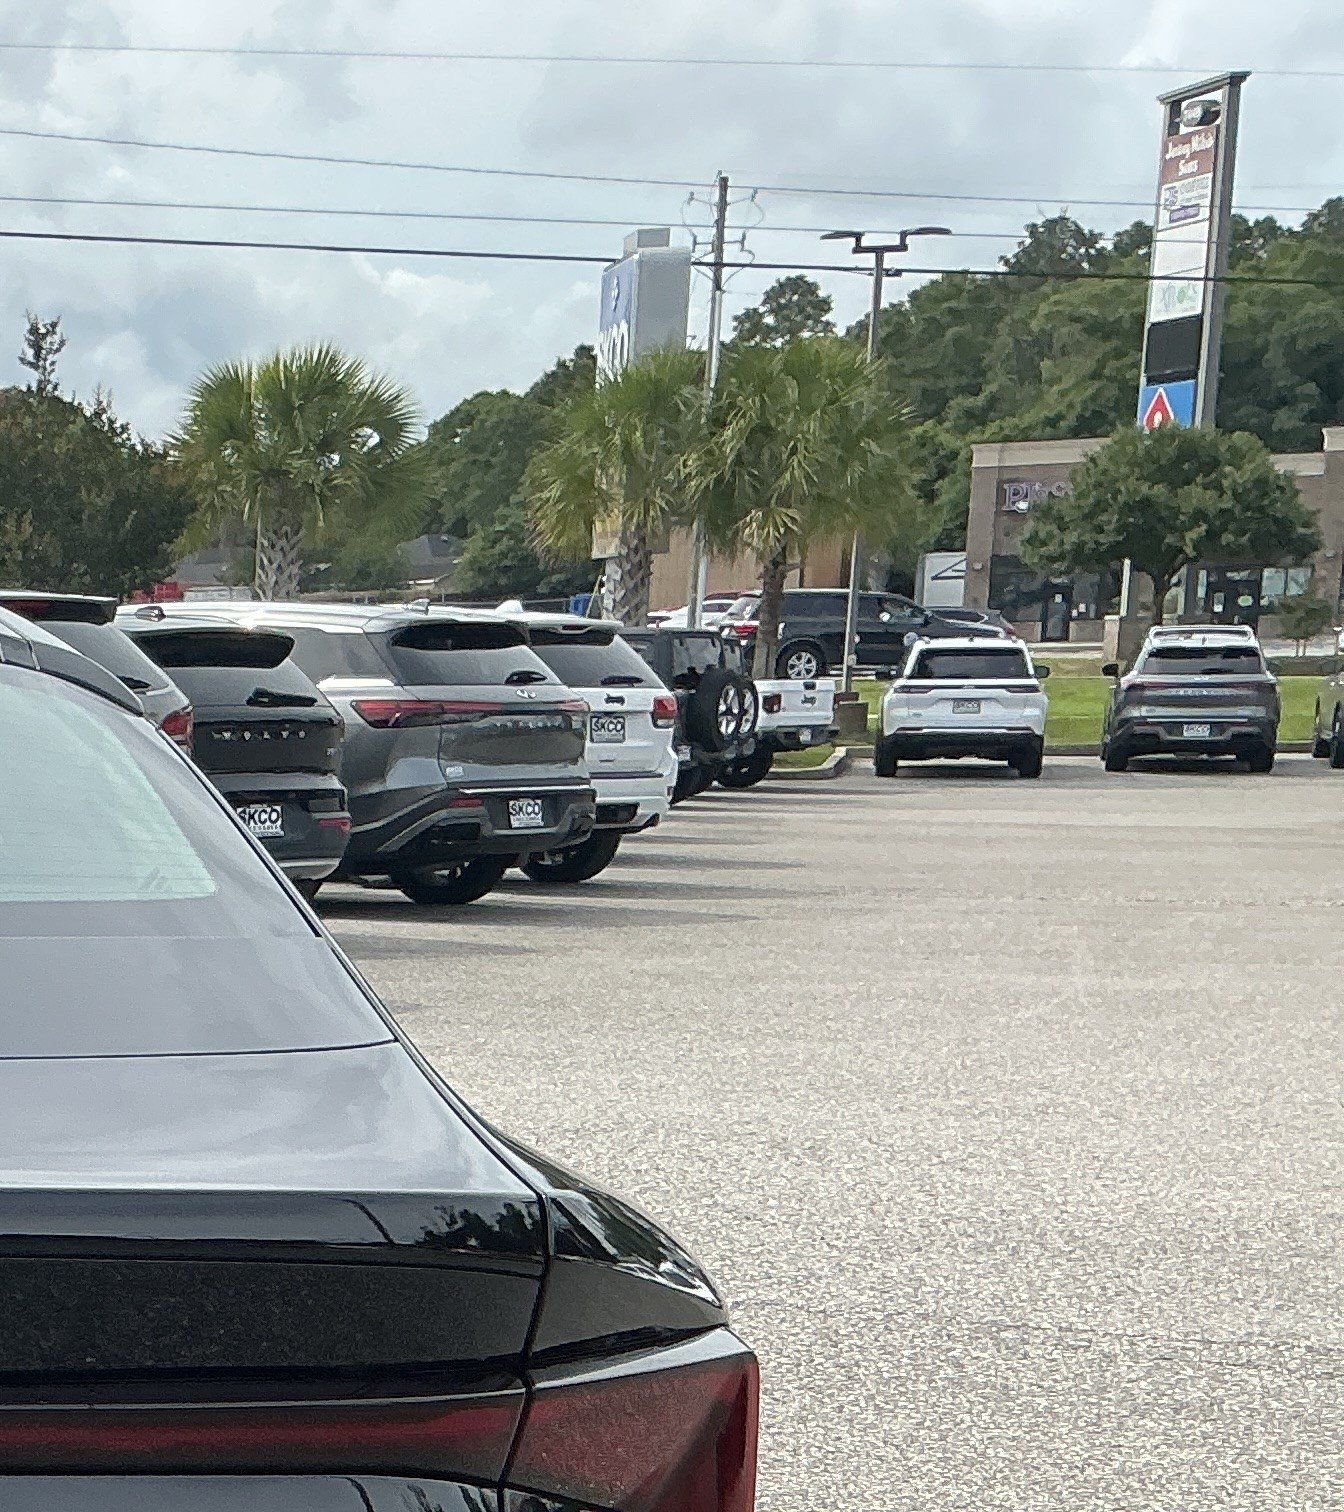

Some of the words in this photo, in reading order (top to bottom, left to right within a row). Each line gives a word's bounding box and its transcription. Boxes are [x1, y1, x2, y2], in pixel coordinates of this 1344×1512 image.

[592, 717, 624, 732] SKCO
[238, 807, 280, 825] SKCO
[509, 803, 541, 815] SKCO
